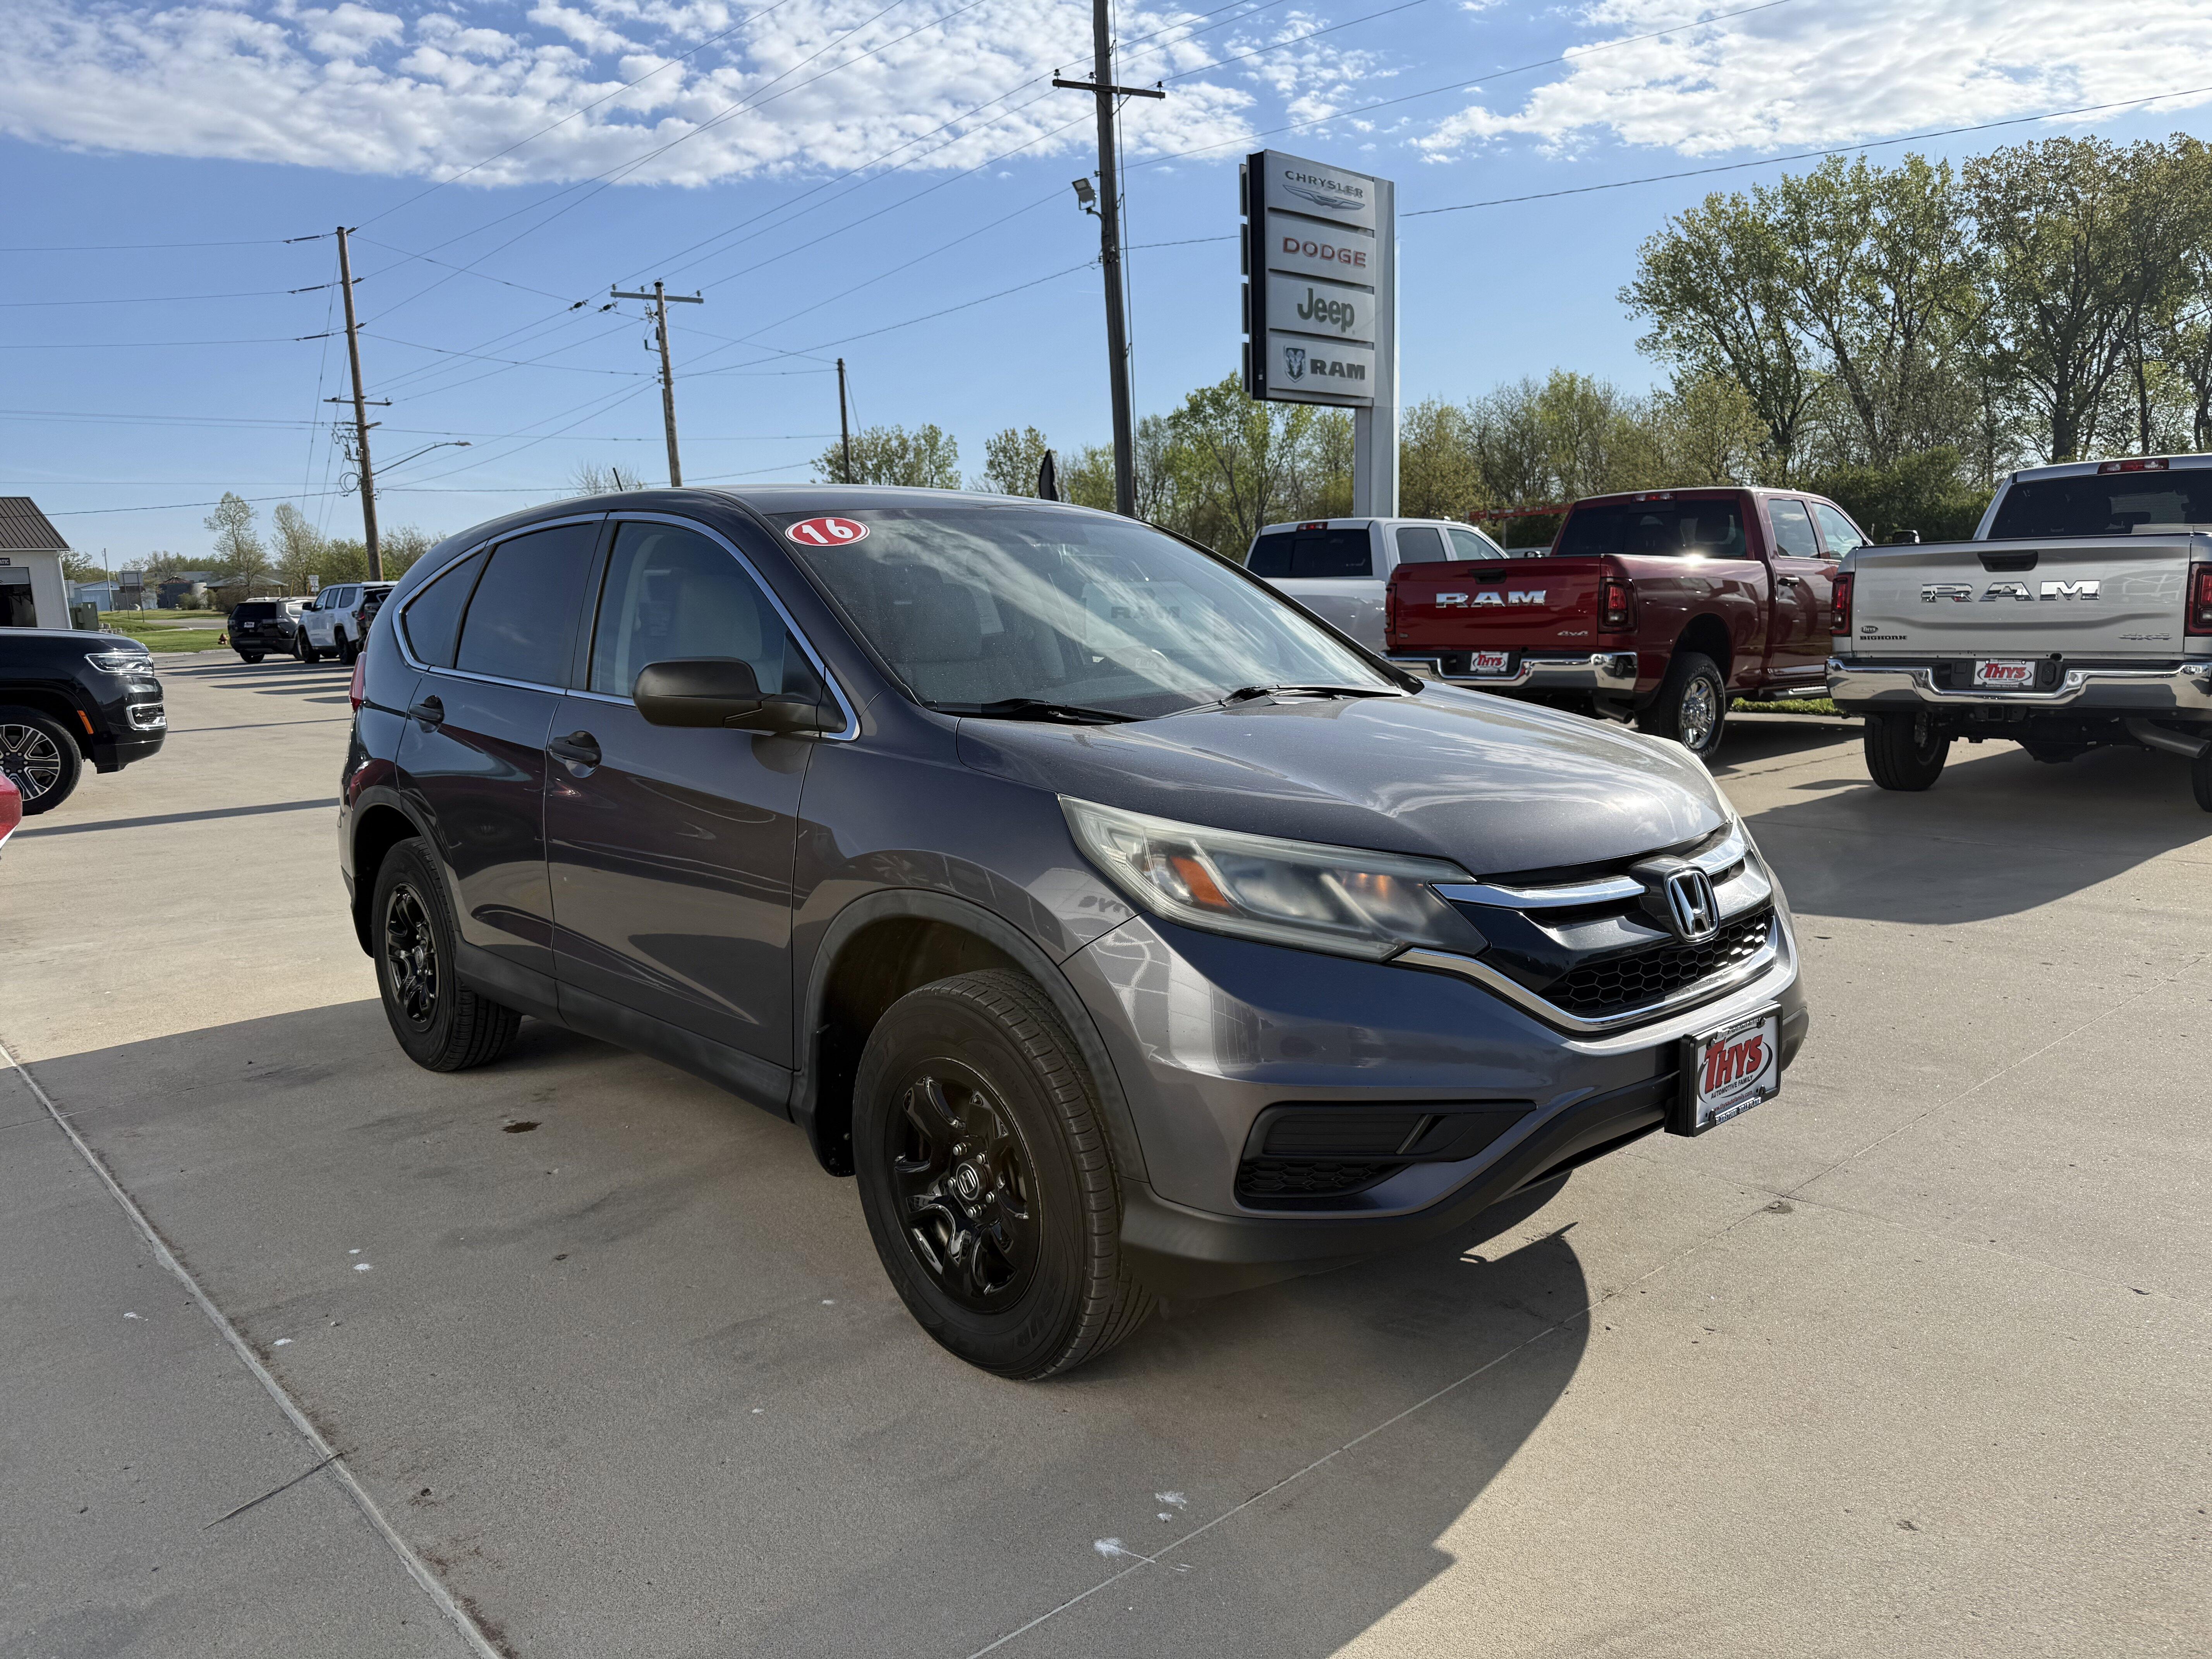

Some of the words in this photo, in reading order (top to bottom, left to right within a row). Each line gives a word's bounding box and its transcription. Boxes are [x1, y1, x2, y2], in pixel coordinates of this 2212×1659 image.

[1285, 170, 1364, 198] CHRYSLER
[1283, 237, 1366, 268] DODGE
[1297, 288, 1355, 332] Jeep
[1310, 359, 1365, 380] RAM
[802, 519, 853, 543] 16
[1436, 590, 1547, 608] RAM
[1920, 579, 2101, 603] RAM
[1477, 654, 1502, 666] THYS
[1984, 663, 2026, 678] THYS
[1704, 1034, 1763, 1094] THYS
[1711, 1082, 1737, 1099] AUTOMOTIVE
[1738, 1075, 1753, 1086] FAMILY
